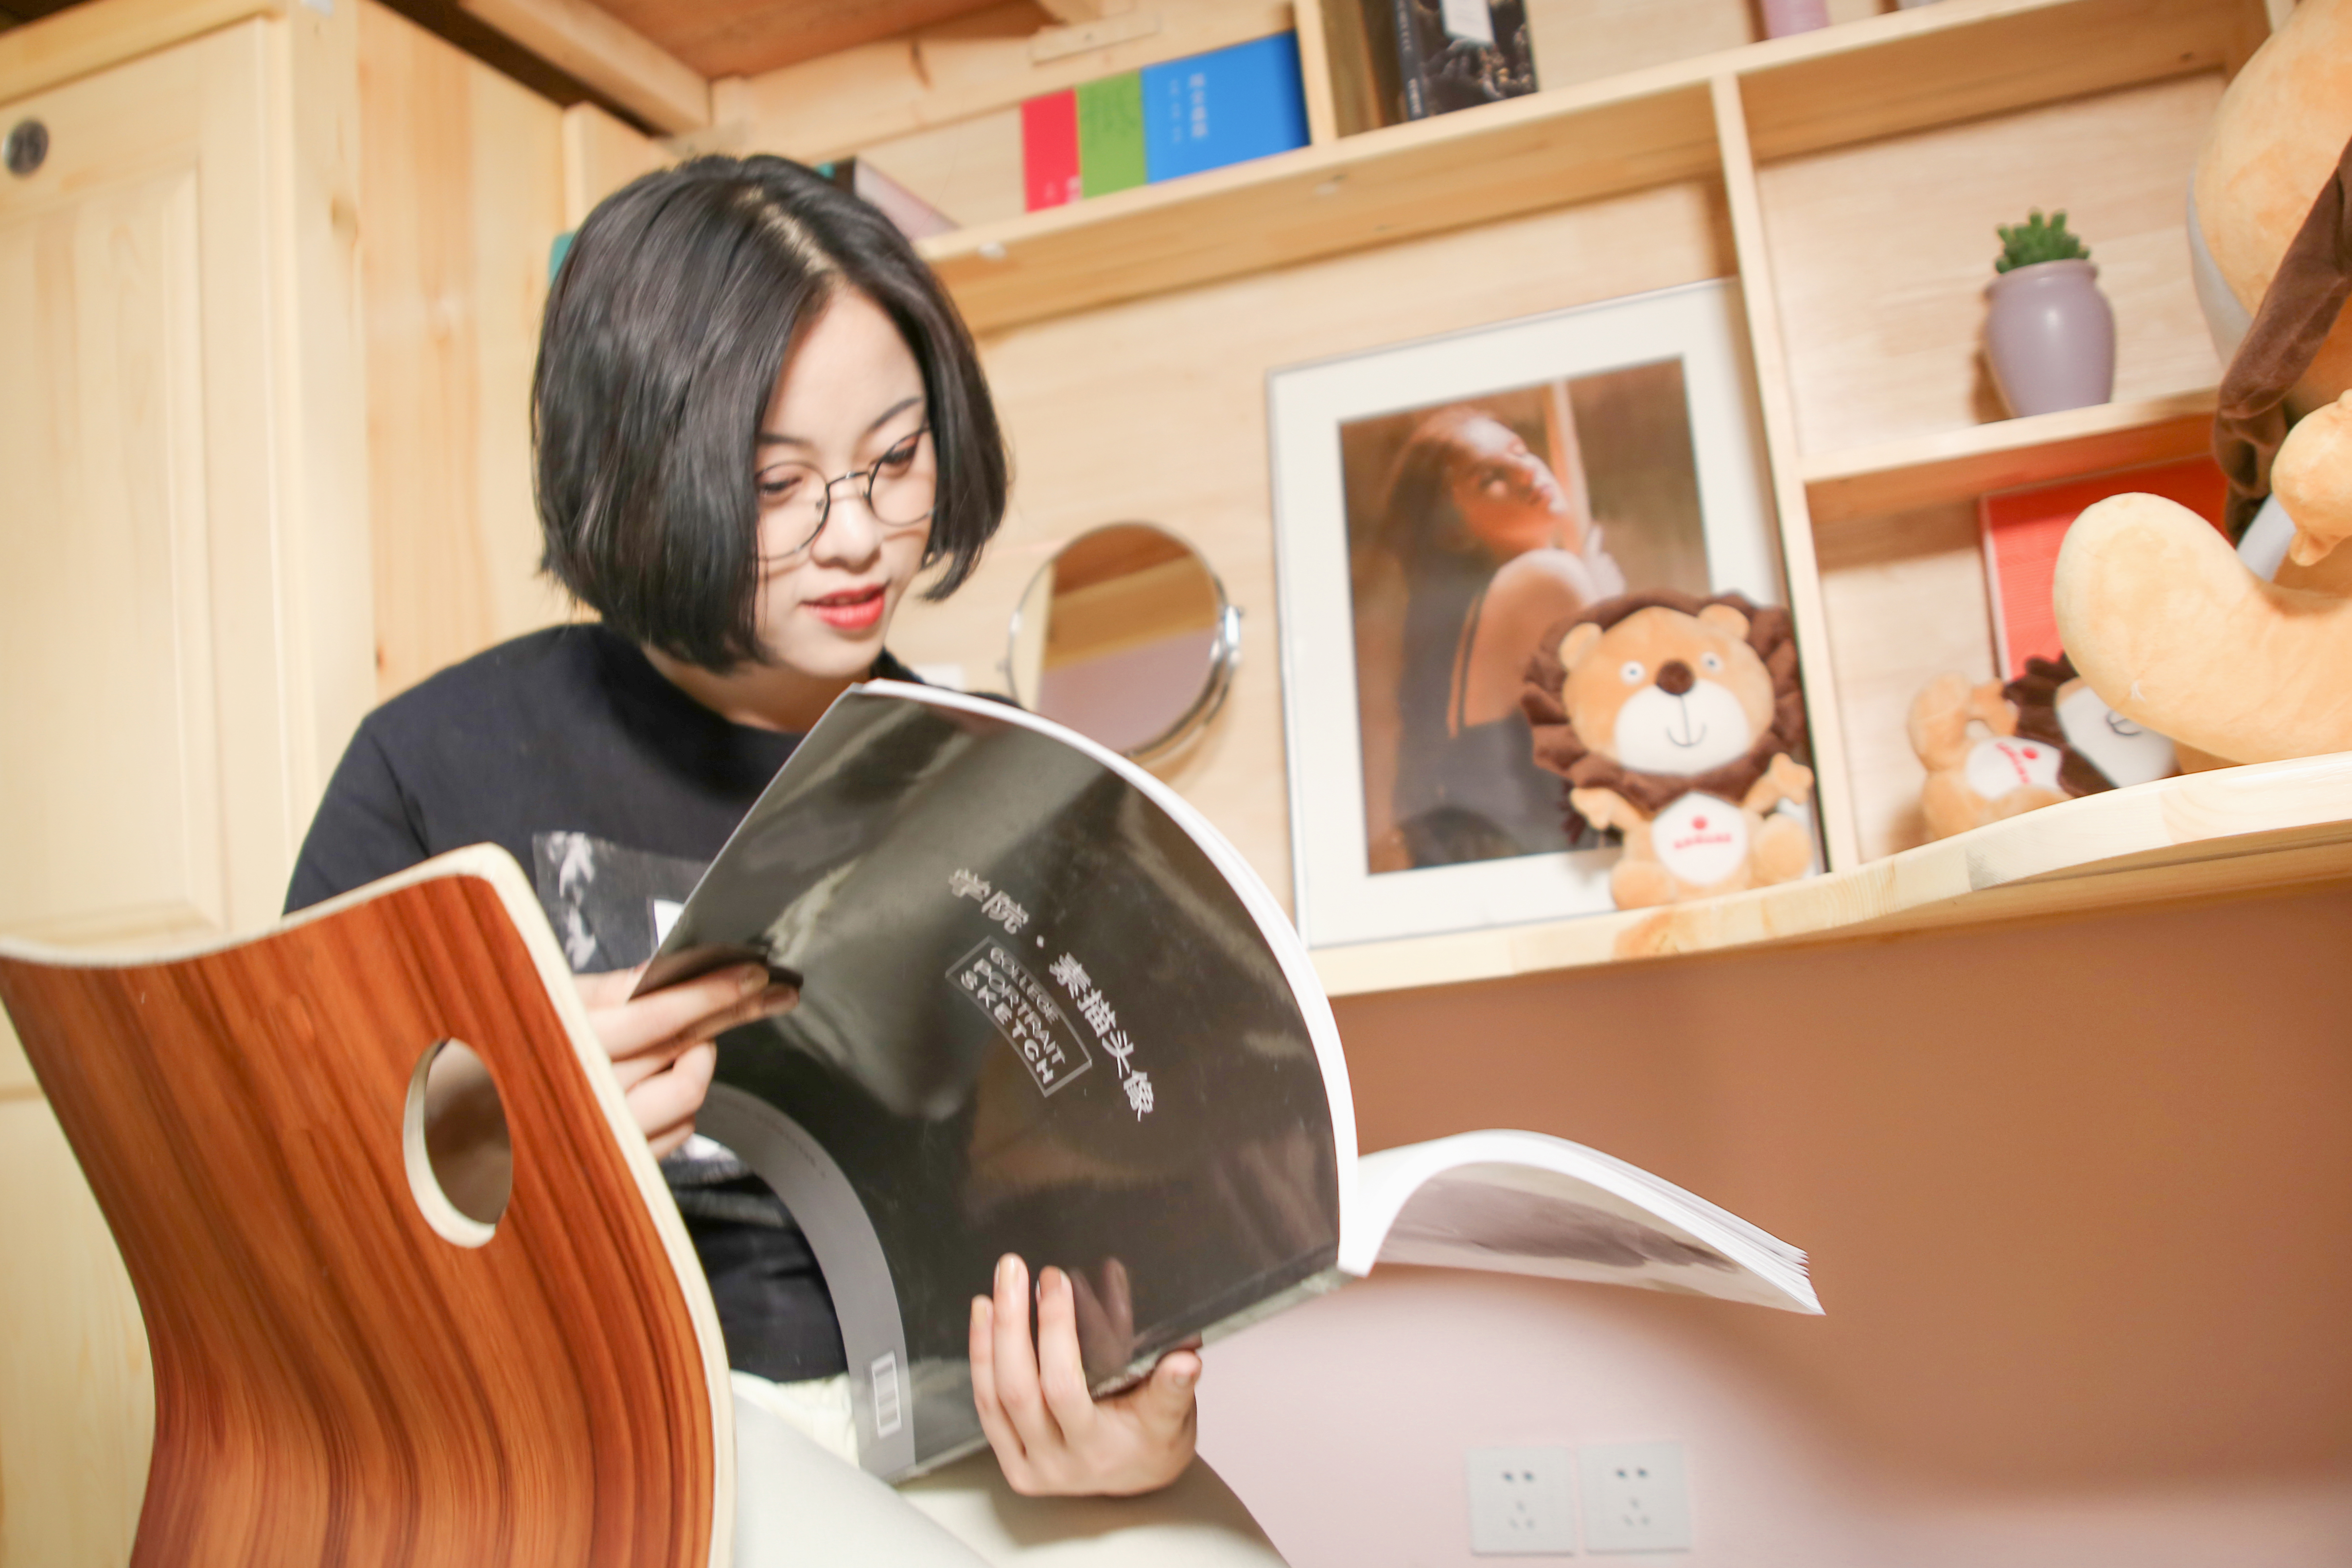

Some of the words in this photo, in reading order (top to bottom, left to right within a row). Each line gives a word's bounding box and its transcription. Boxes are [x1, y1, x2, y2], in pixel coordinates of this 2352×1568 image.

[961, 970, 1054, 1084] SKETCH
[974, 958, 1066, 1064] PORTRAIT
[991, 947, 1059, 1024] COLLEGE
